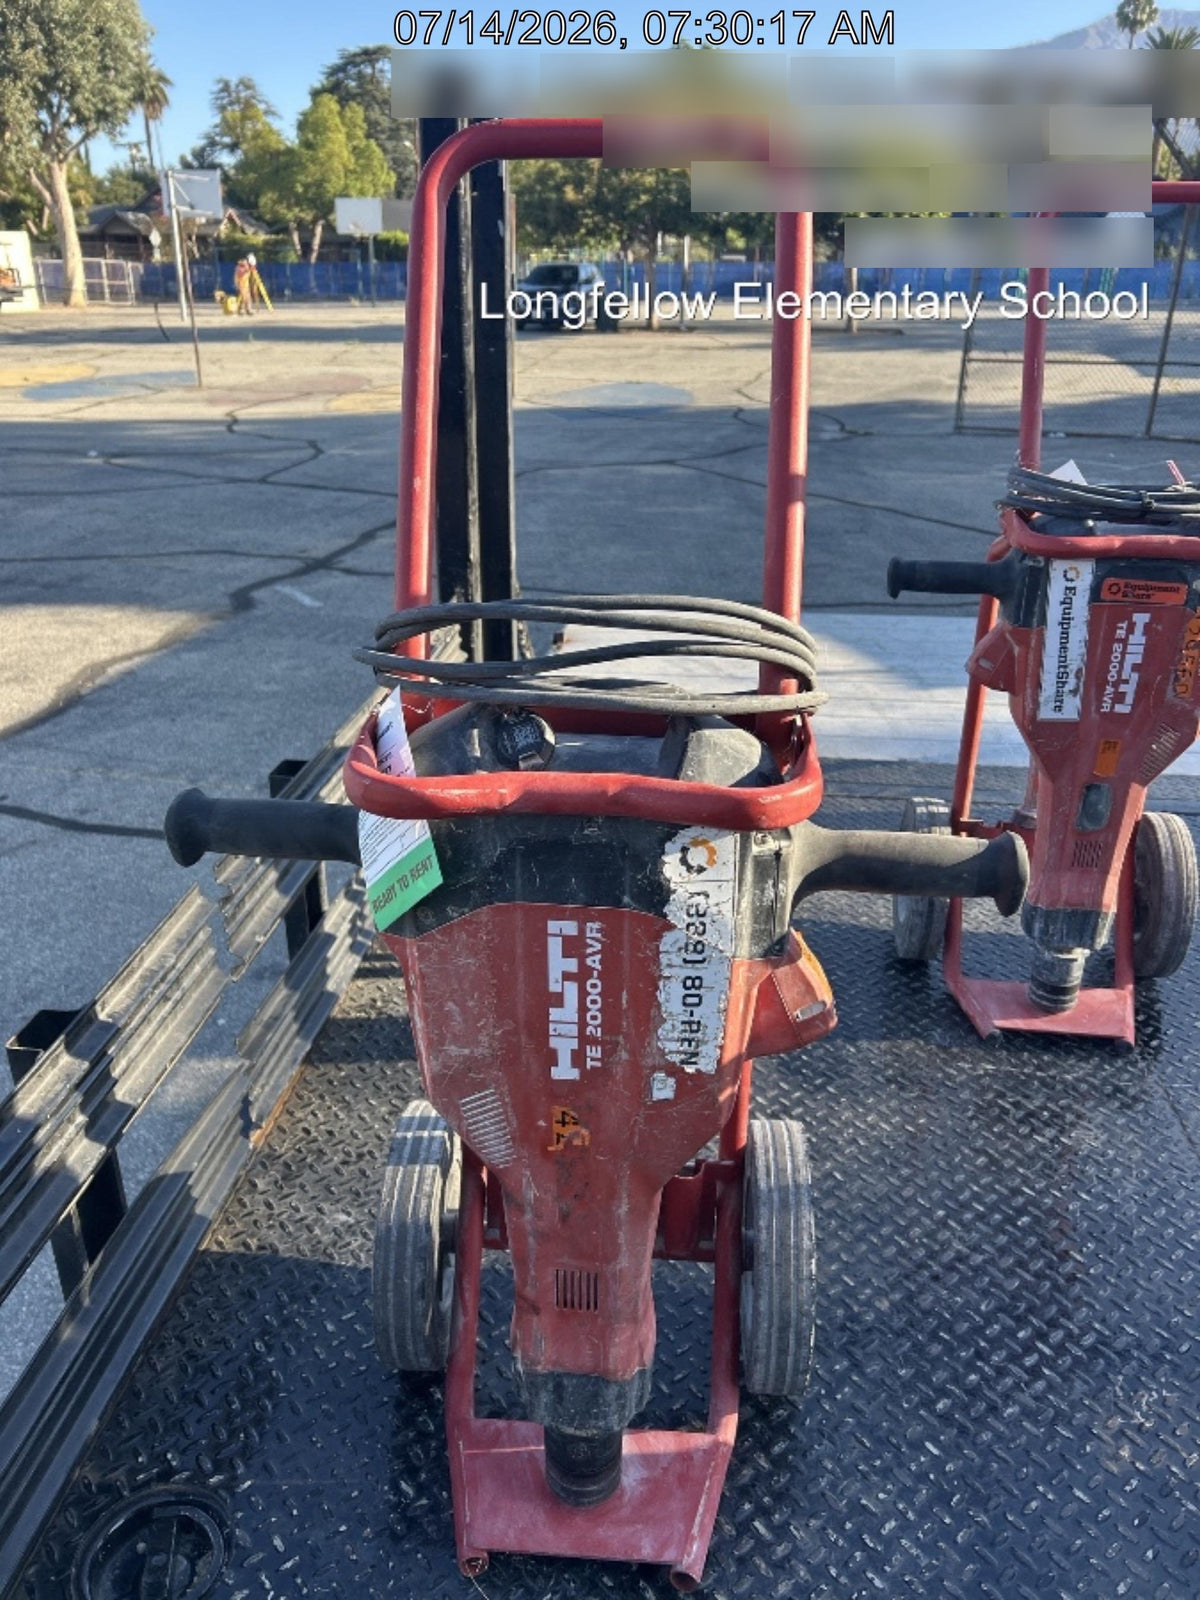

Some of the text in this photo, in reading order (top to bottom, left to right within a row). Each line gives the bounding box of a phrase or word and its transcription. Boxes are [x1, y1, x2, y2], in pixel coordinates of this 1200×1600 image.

[1053, 585, 1078, 714] EquipmentShare
[1100, 620, 1129, 713] TE 2000-AVR
[1114, 612, 1151, 714] HILTI
[372, 856, 434, 914] READY TO RENT
[547, 920, 580, 1080] HILTI
[586, 921, 605, 1070] TE 2000-AVR
